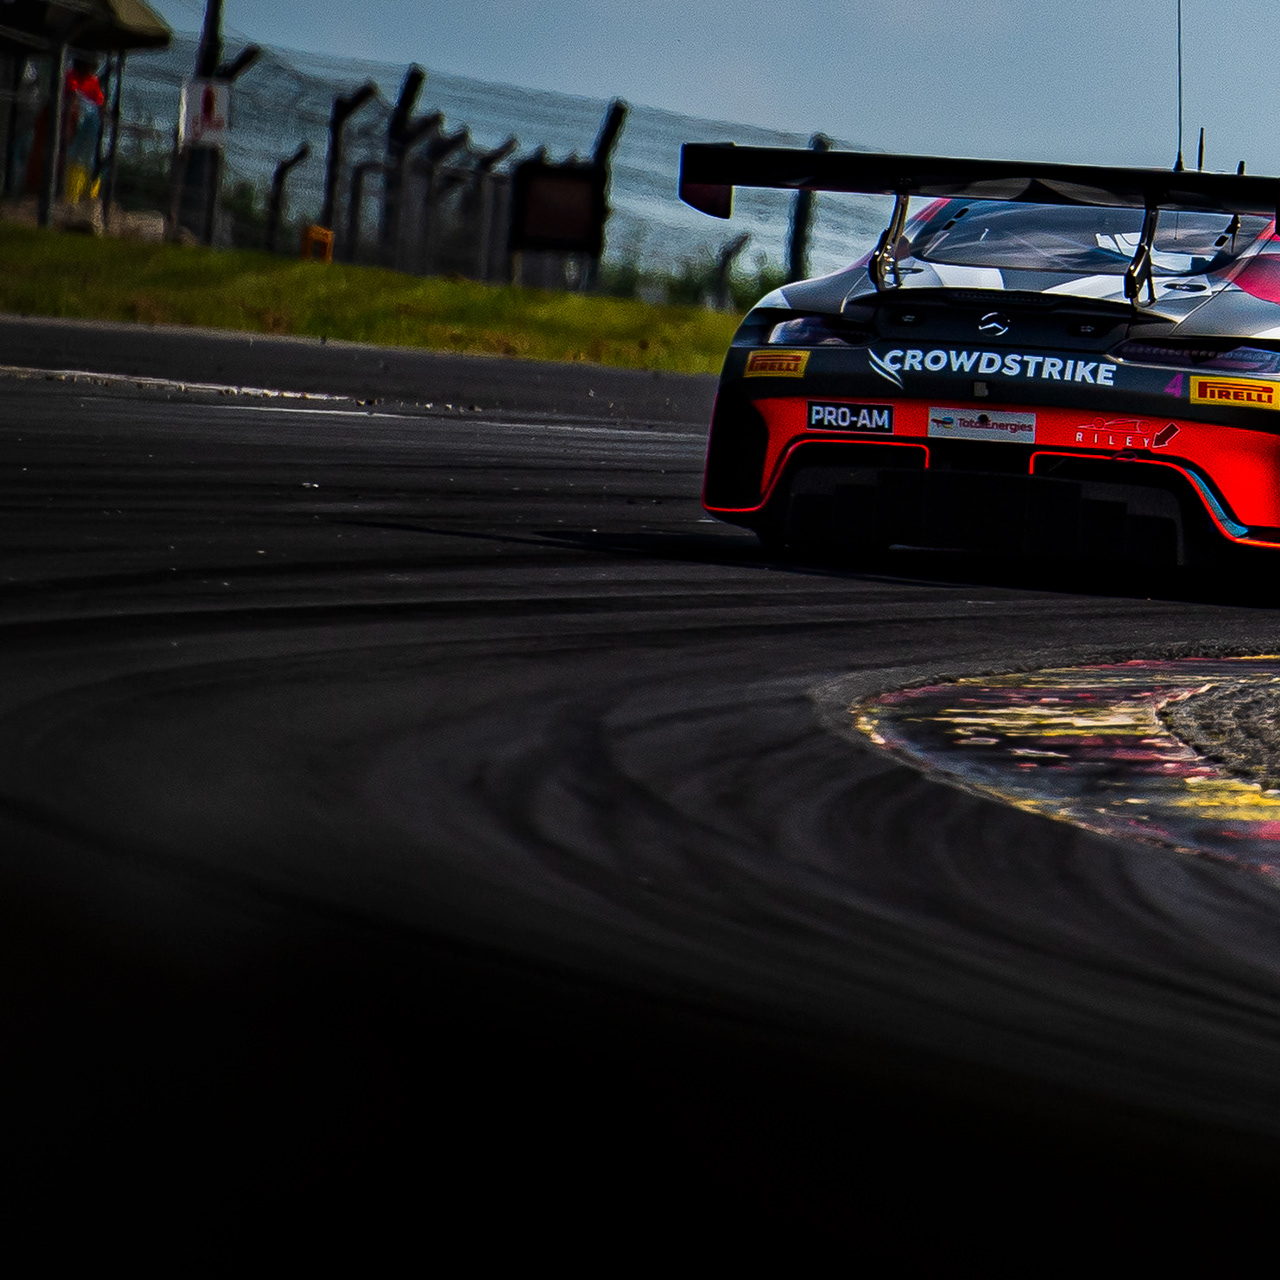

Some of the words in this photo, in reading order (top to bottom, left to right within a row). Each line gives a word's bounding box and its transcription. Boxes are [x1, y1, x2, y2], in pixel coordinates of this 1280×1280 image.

[749, 354, 802, 371] PIRELLI
[883, 349, 1118, 386] CROWDSTRIKE
[1163, 373, 1184, 398] 4
[1198, 381, 1274, 404] PIRELLI
[811, 405, 889, 429] PRO-AM
[957, 417, 1034, 434] TotalEnergies
[1075, 431, 1150, 448] RILEY
